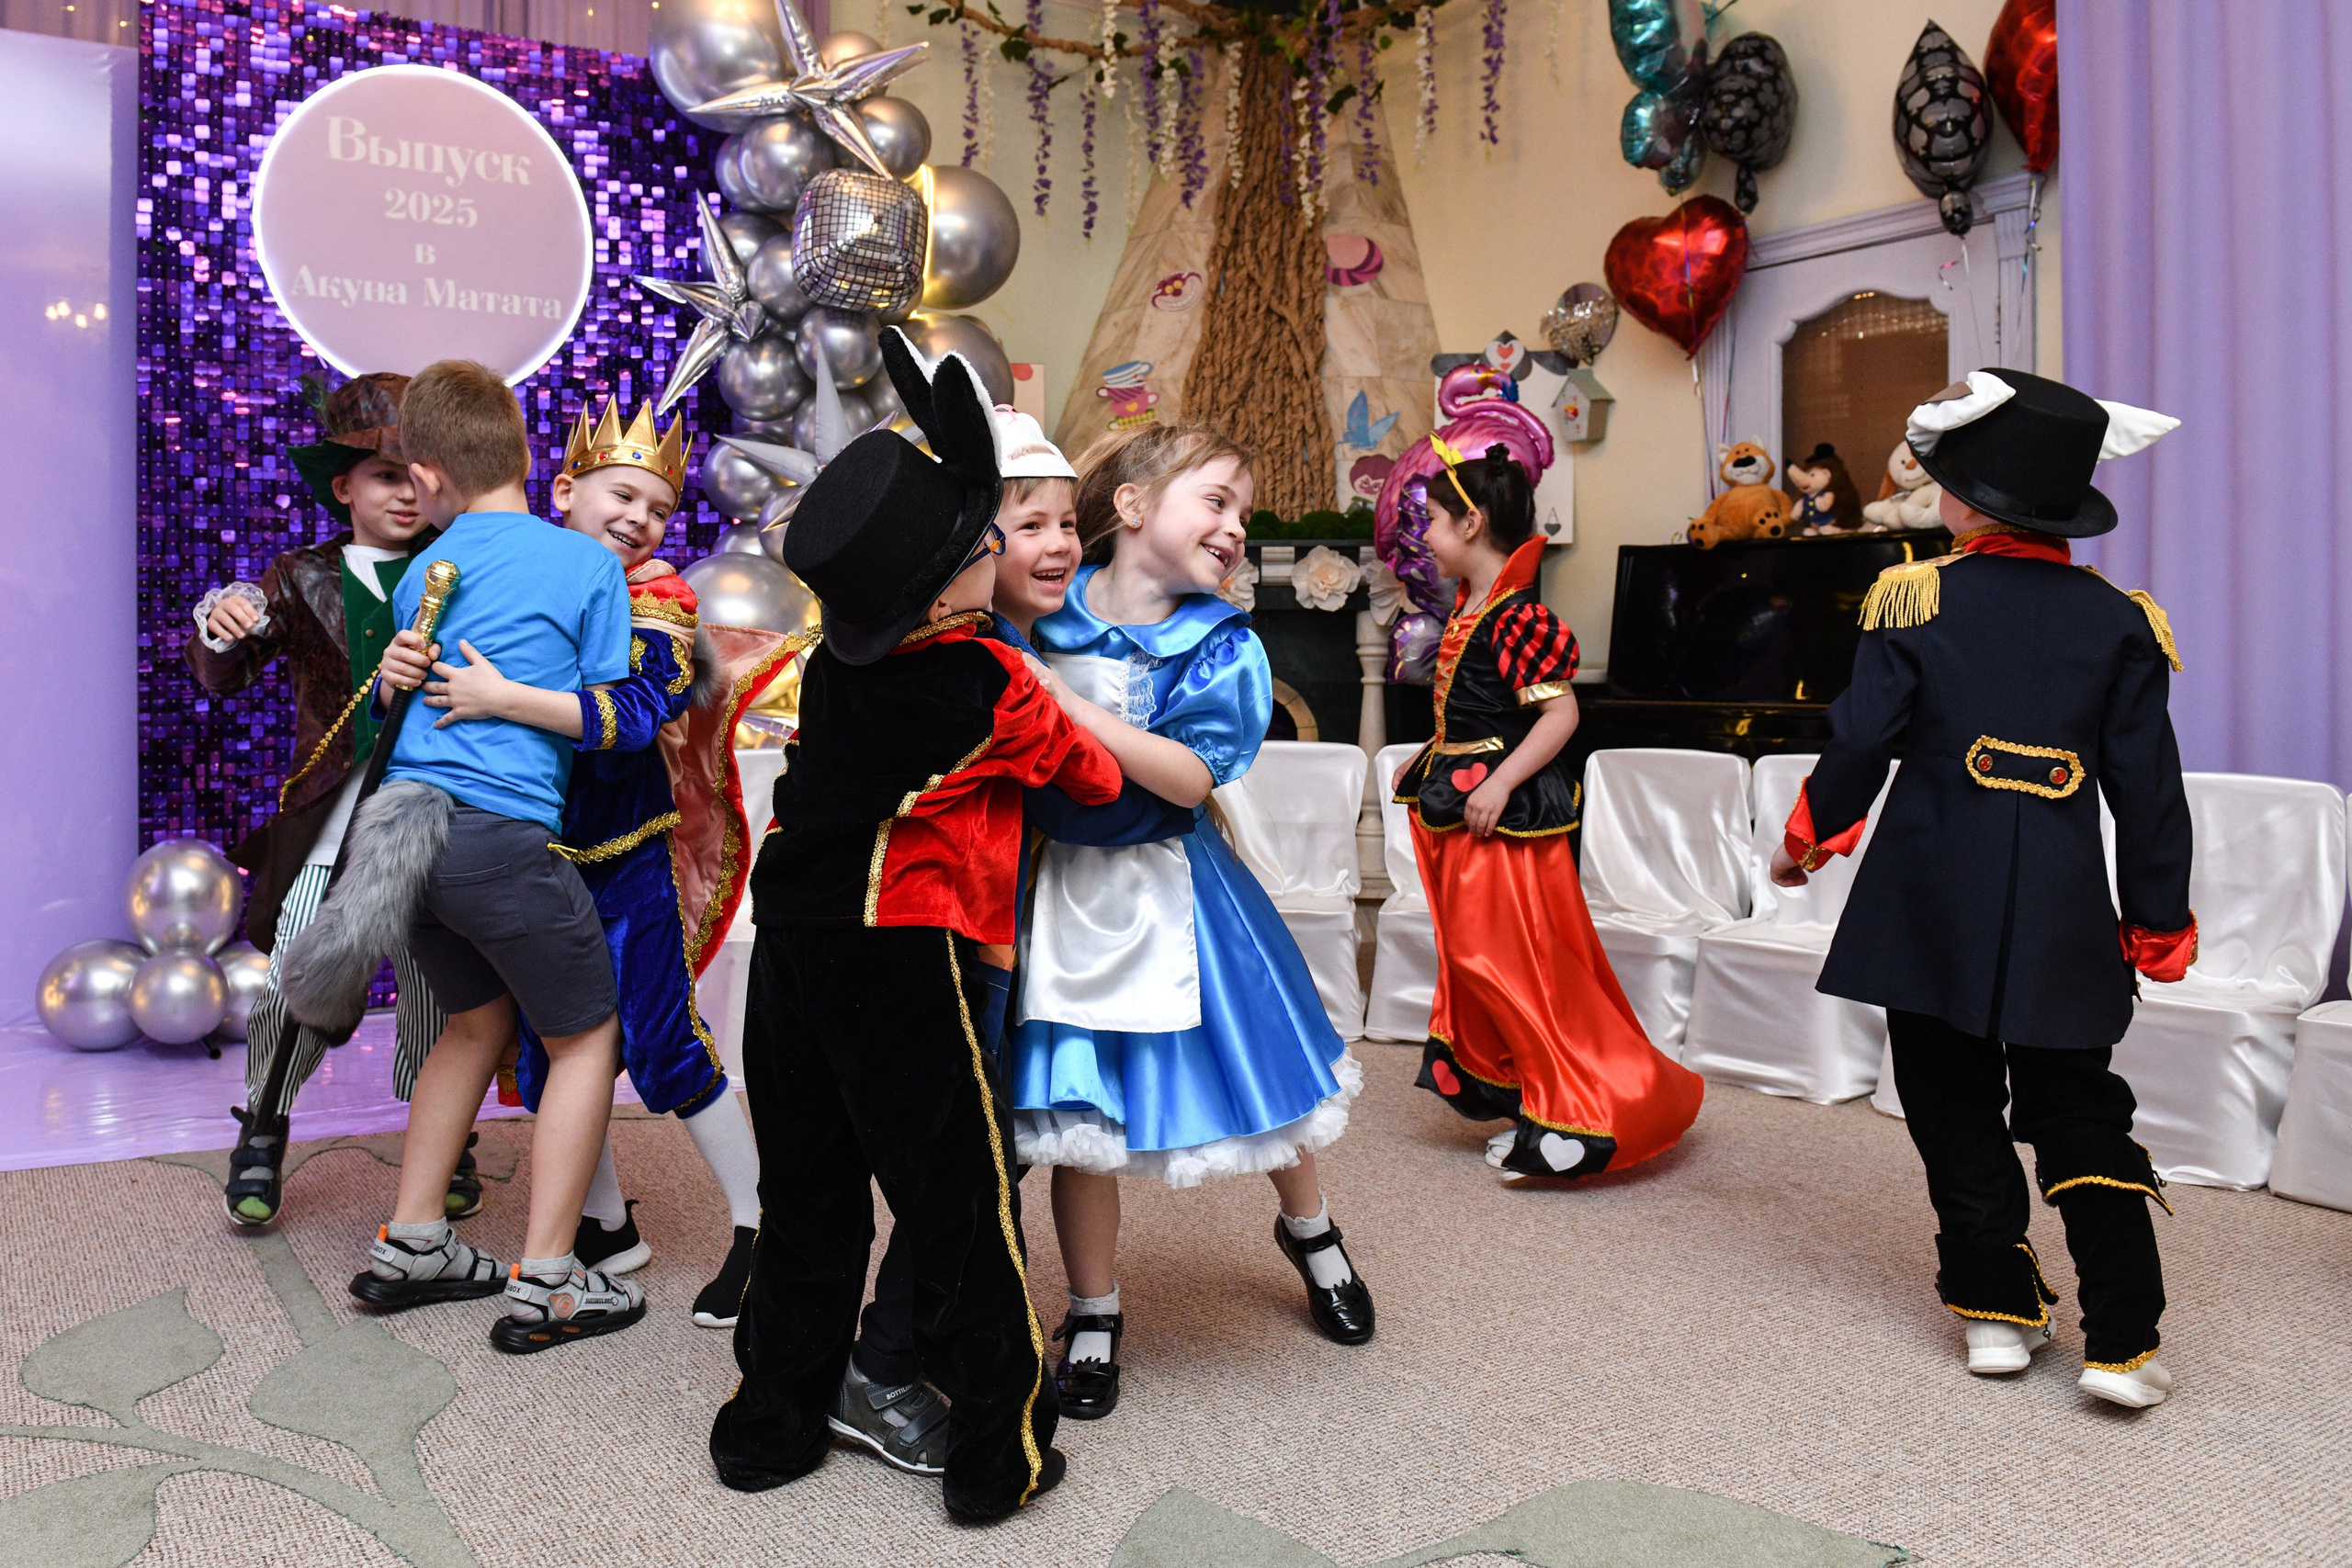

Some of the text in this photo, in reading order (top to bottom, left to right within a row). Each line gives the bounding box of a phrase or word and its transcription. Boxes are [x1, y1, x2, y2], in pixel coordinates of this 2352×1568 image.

[326, 116, 532, 186] Выпуск
[384, 187, 479, 228] 2025
[414, 243, 436, 265] в
[290, 265, 563, 320] Акуна Матата
